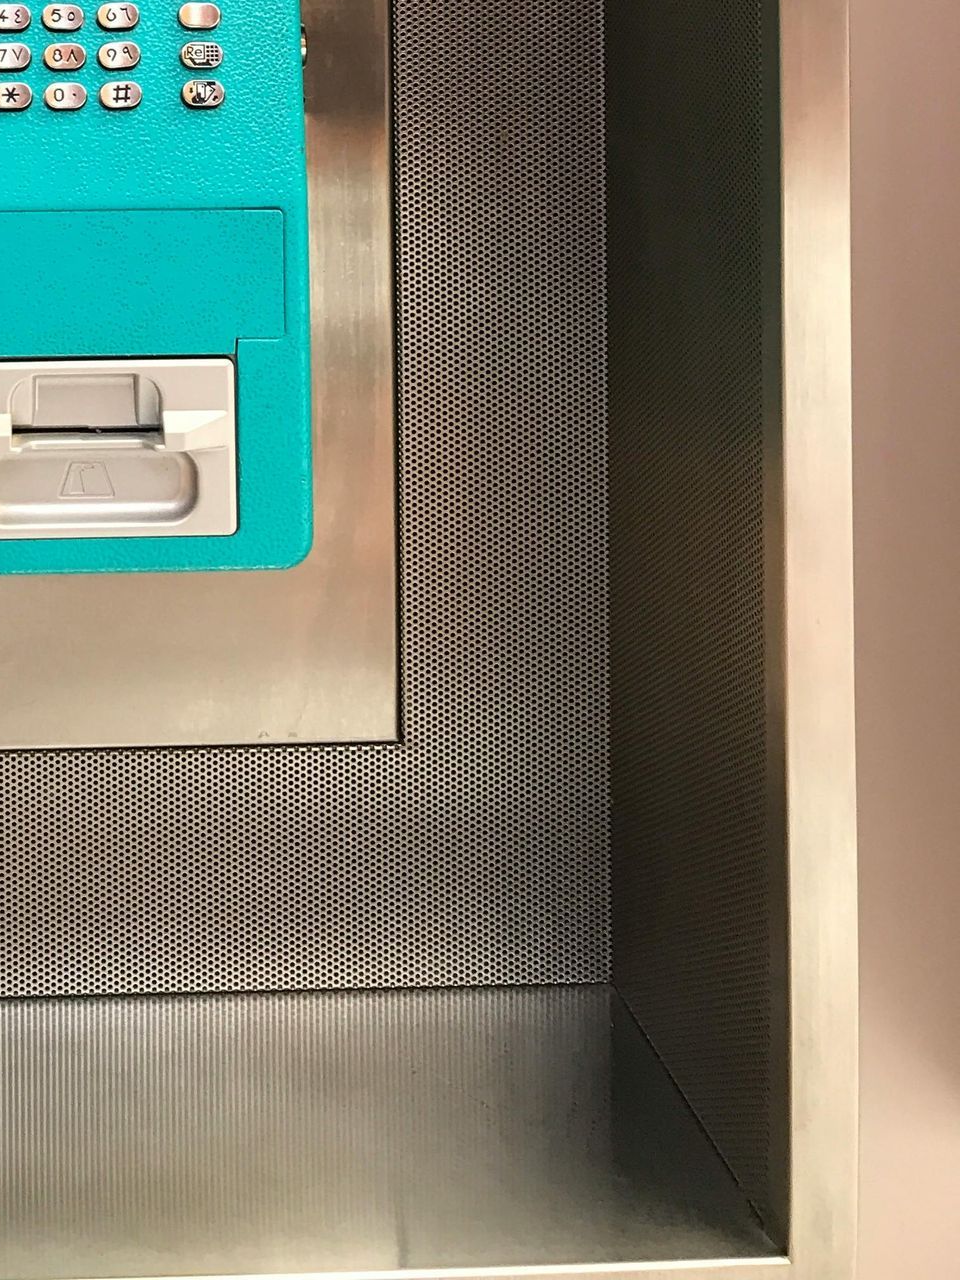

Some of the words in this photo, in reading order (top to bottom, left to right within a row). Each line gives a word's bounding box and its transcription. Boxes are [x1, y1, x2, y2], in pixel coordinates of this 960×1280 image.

[51, 8, 62, 23] 5
[106, 8, 117, 22] 6
[52, 48, 63, 63] 8
[106, 48, 117, 62] 9
[186, 46, 203, 58] Re
[53, 88, 65, 102] 0
